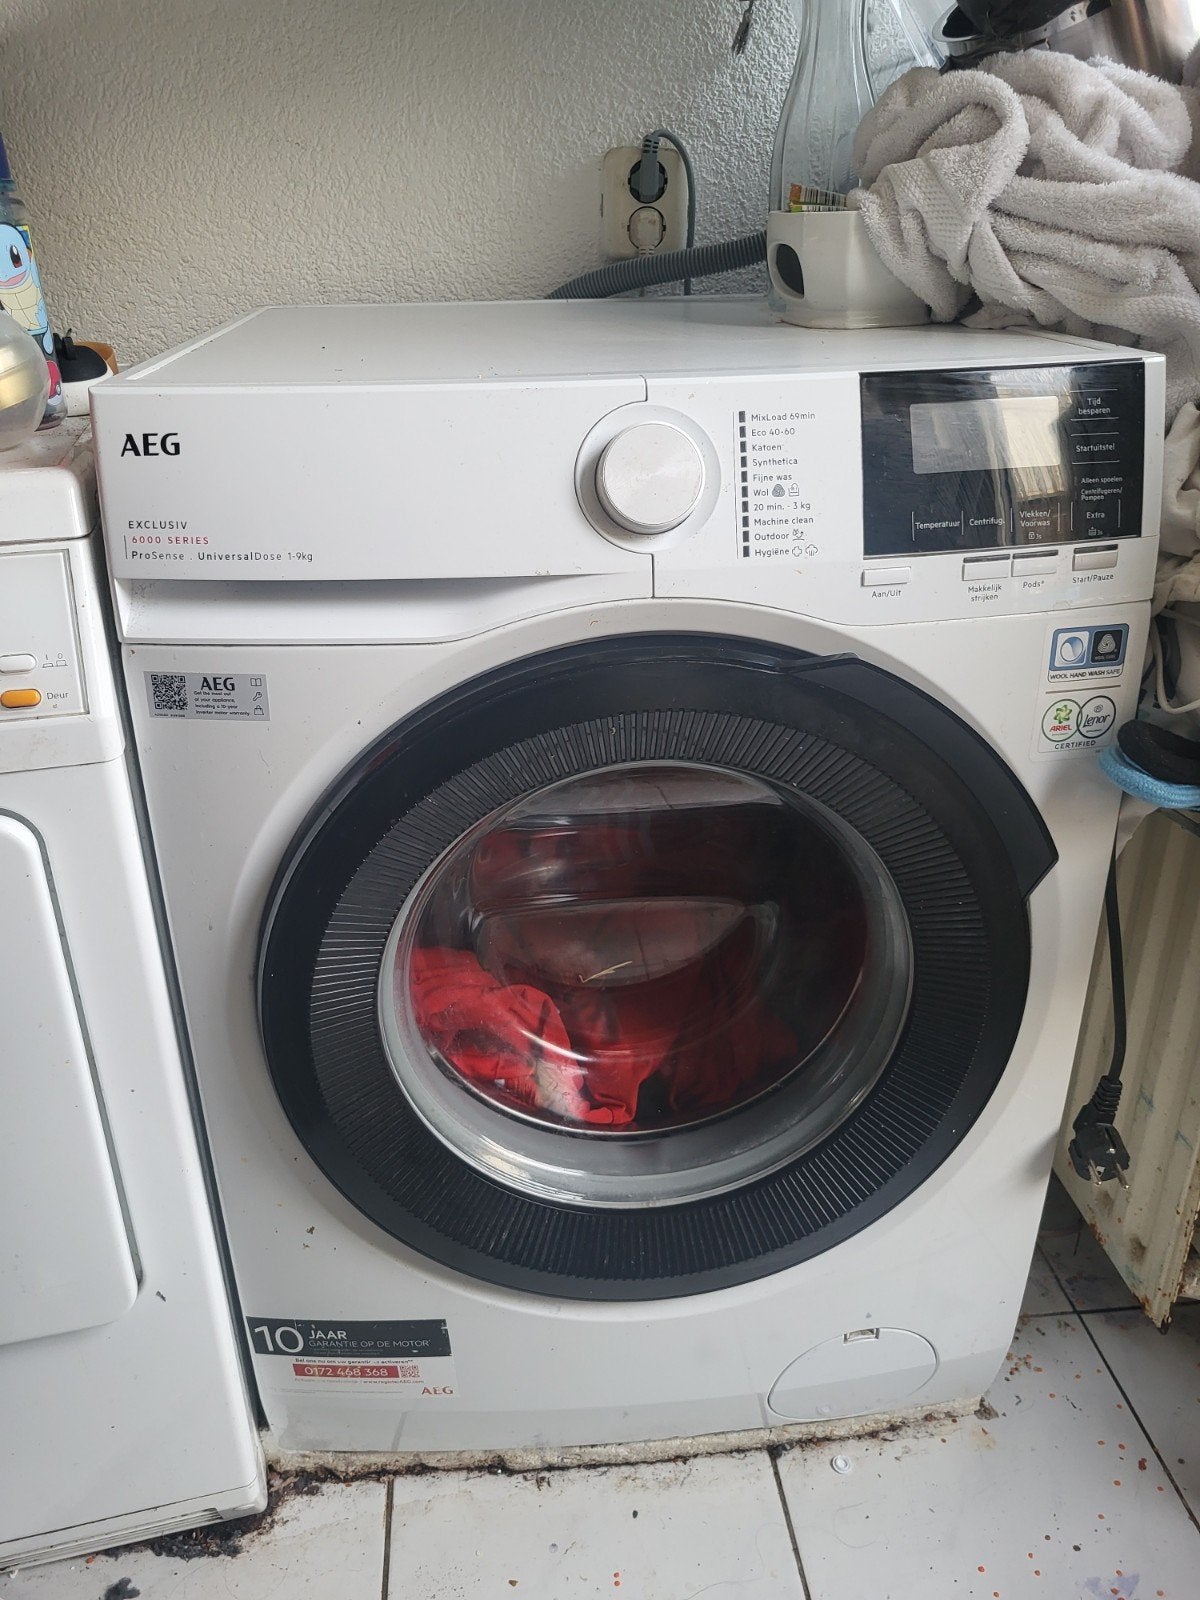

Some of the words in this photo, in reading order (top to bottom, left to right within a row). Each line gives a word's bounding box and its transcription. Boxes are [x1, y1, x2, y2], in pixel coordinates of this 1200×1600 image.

[1087, 397, 1101, 406] Tijd
[751, 413, 788, 422] MixLoad
[789, 411, 816, 421] 69min
[1078, 407, 1111, 416] besparen
[751, 428, 767, 437] Eco
[769, 427, 796, 436] 40-60
[121, 432, 181, 457] AEG
[752, 444, 782, 452] Katoen
[1075, 443, 1116, 453] Startuitstel
[752, 457, 798, 468] Synthetica
[753, 473, 774, 484] Fijne
[1100, 476, 1123, 484] spoelen
[753, 488, 769, 497] Wol
[753, 503, 764, 511] 20
[766, 502, 785, 510] min.
[793, 501, 798, 510] 3
[800, 501, 811, 511] kg
[1019, 508, 1051, 518] Vlekken/
[1086, 511, 1106, 519] Extra
[128, 520, 188, 530] EXCLUSIV
[754, 517, 789, 526] Machine
[791, 516, 814, 525] clean
[914, 520, 961, 530] Temperatuur
[968, 516, 1006, 526] Centrifug.
[1019, 519, 1051, 528] Voorwas
[131, 535, 162, 545] 6000
[167, 536, 210, 546] SERIES
[754, 532, 790, 541] Outdoor
[131, 550, 185, 561] ProSense
[197, 551, 283, 562] UniversalDose
[287, 551, 313, 563] 1-9kg
[755, 547, 790, 558] Hygiëne
[1072, 573, 1115, 584] Start/Pauze
[871, 589, 902, 598] Aan/Uit
[967, 584, 1002, 594] Makkelijk
[970, 593, 999, 603] strijken
[1070, 671, 1087, 679] HAND
[1088, 669, 1105, 677] WASH
[1106, 668, 1121, 676] SAFE
[200, 676, 236, 691] AEG
[46, 692, 69, 700] Deur
[1082, 714, 1111, 729] Lenor
[1049, 724, 1073, 732] ARIEL
[1054, 739, 1097, 750] CERTIFIED
[253, 1325, 305, 1353] 10
[308, 1330, 348, 1340] JAAR
[308, 1339, 359, 1348] GARANTIE
[360, 1340, 375, 1348] OP
[376, 1340, 391, 1348] DE
[304, 1366, 334, 1376] 0172
[337, 1367, 362, 1377] 468
[364, 1368, 389, 1377] 368
[421, 1385, 454, 1395] AEG
